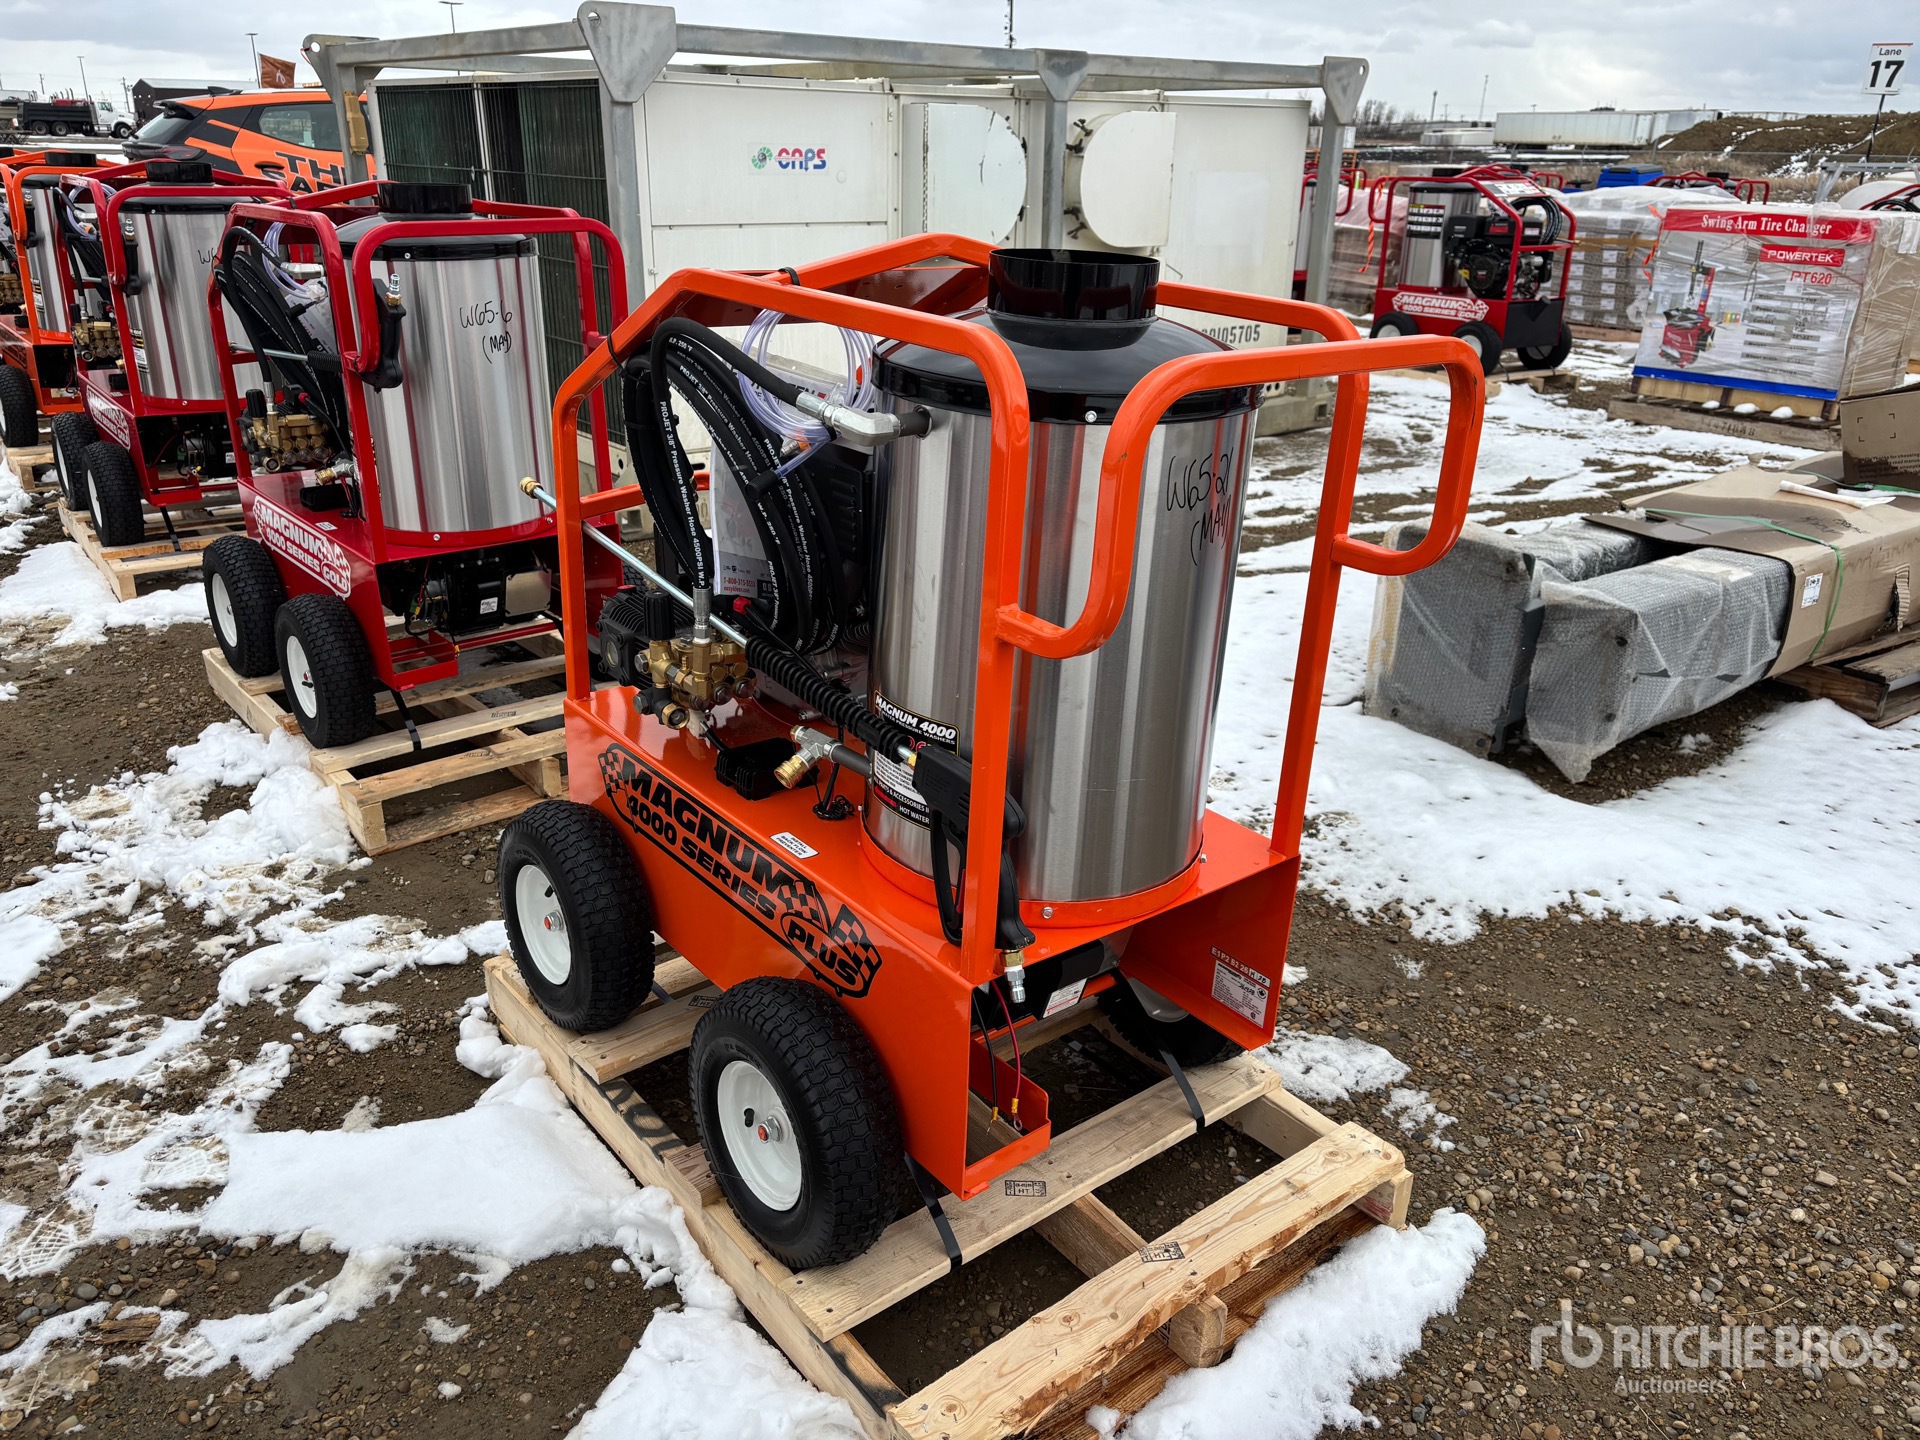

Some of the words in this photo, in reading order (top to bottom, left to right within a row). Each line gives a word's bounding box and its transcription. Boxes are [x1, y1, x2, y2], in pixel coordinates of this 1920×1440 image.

[1879, 48, 1902, 56] Lane
[1870, 60, 1905, 88] 17
[1701, 214, 1734, 231] Swing
[1735, 216, 1757, 230] Arm
[1760, 217, 1782, 231] Tire
[1767, 250, 1834, 263] POWERTEK
[1790, 270, 1833, 286] PT620
[460, 300, 512, 328] W65-6
[1400, 295, 1461, 309] MAGNUM
[1423, 306, 1456, 316] SERIES
[660, 400, 674, 432] PROJET
[680, 365, 698, 388] PROJET
[707, 394, 729, 424] Pressure
[728, 422, 746, 450] Washer
[745, 450, 758, 471] Hose
[666, 433, 676, 448] 3/8"
[670, 450, 684, 484] Pressure
[680, 486, 691, 515] Washer
[764, 438, 782, 468] PROJET
[786, 488, 800, 524] Pressure
[798, 524, 808, 554] Washer
[260, 504, 324, 559] MAGNUM
[688, 516, 697, 536] Hose
[266, 527, 286, 550] 4000
[286, 540, 320, 573] SERIES
[322, 565, 348, 592] GOLD
[693, 538, 704, 570] 4500PSI
[876, 694, 919, 728] MAGNUM
[919, 721, 956, 740] 4000
[896, 720, 922, 734] PRESSURE
[923, 730, 956, 744] WASHERS
[892, 791, 925, 812] ACCESSORIES
[900, 805, 910, 816] HOT
[910, 810, 930, 824] WATER
[622, 756, 797, 896] MAGNUM
[627, 794, 678, 846] 4000
[680, 836, 777, 920] SERIES
[788, 919, 858, 986] PLUS
